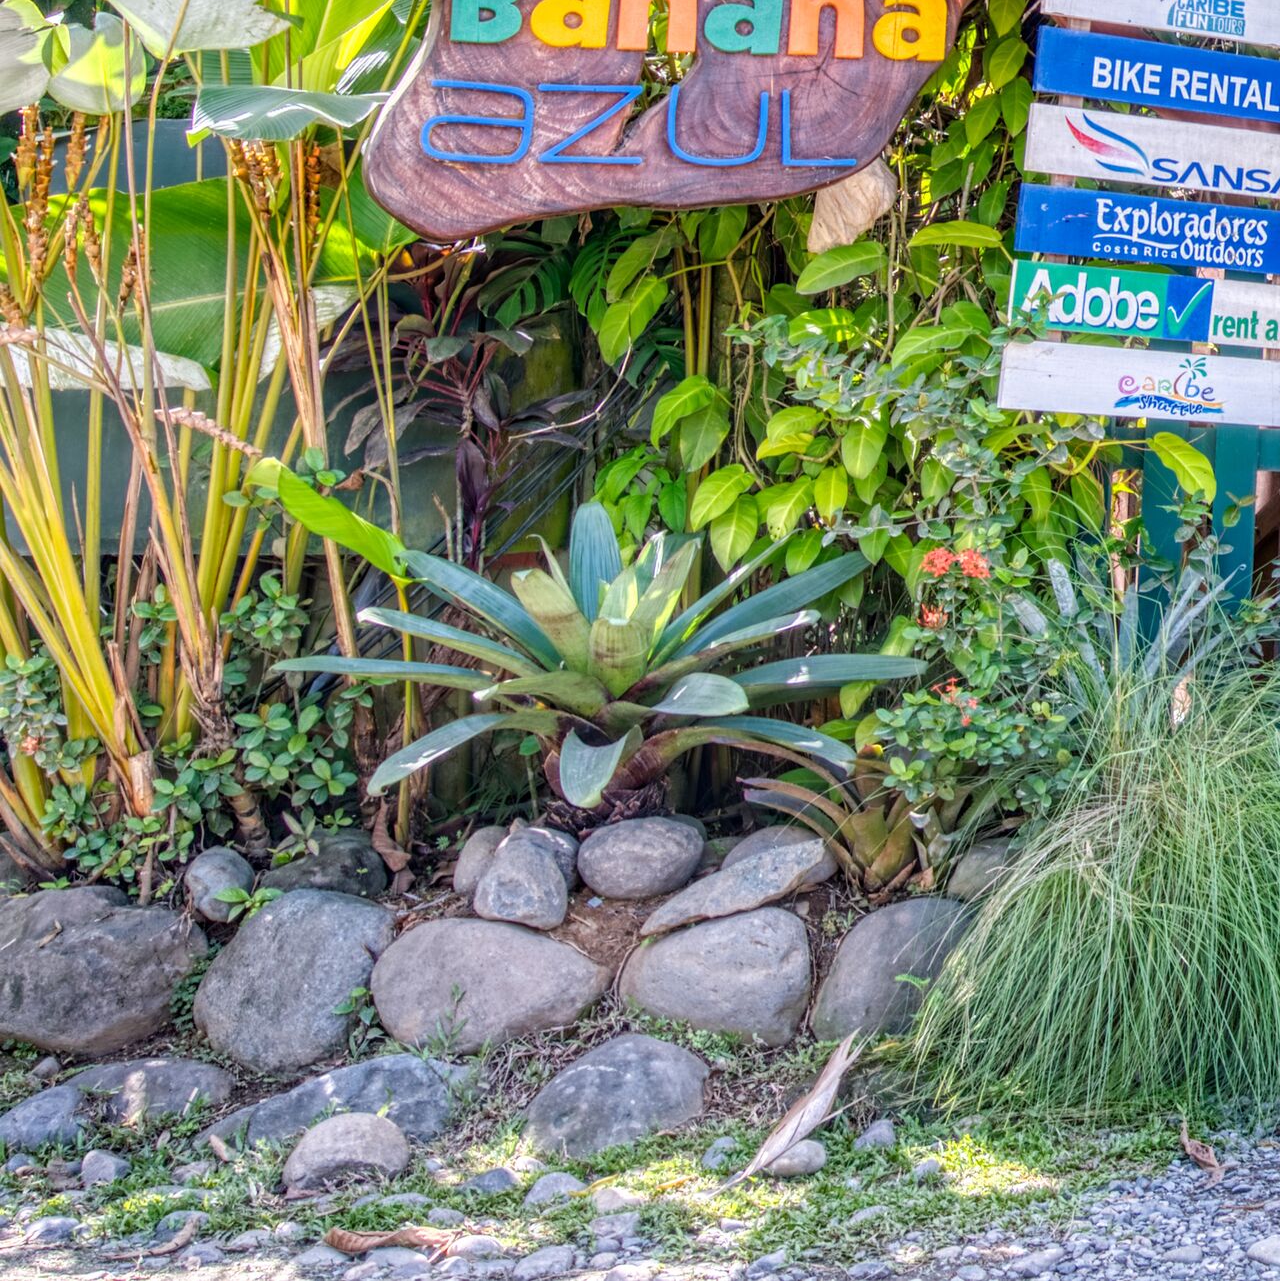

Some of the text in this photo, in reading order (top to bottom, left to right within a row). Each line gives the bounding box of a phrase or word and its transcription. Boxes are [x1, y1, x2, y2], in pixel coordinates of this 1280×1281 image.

[1176, 10, 1244, 34] FUN TOURS
[1092, 56, 1162, 97] BIKE
[1096, 198, 1268, 246] Exploradores
[1092, 241, 1138, 256] Costa
[1179, 237, 1264, 268] Outdoors
[1020, 268, 1161, 331] Adobe
[1212, 311, 1258, 340] rent
[1265, 320, 1279, 341] a
